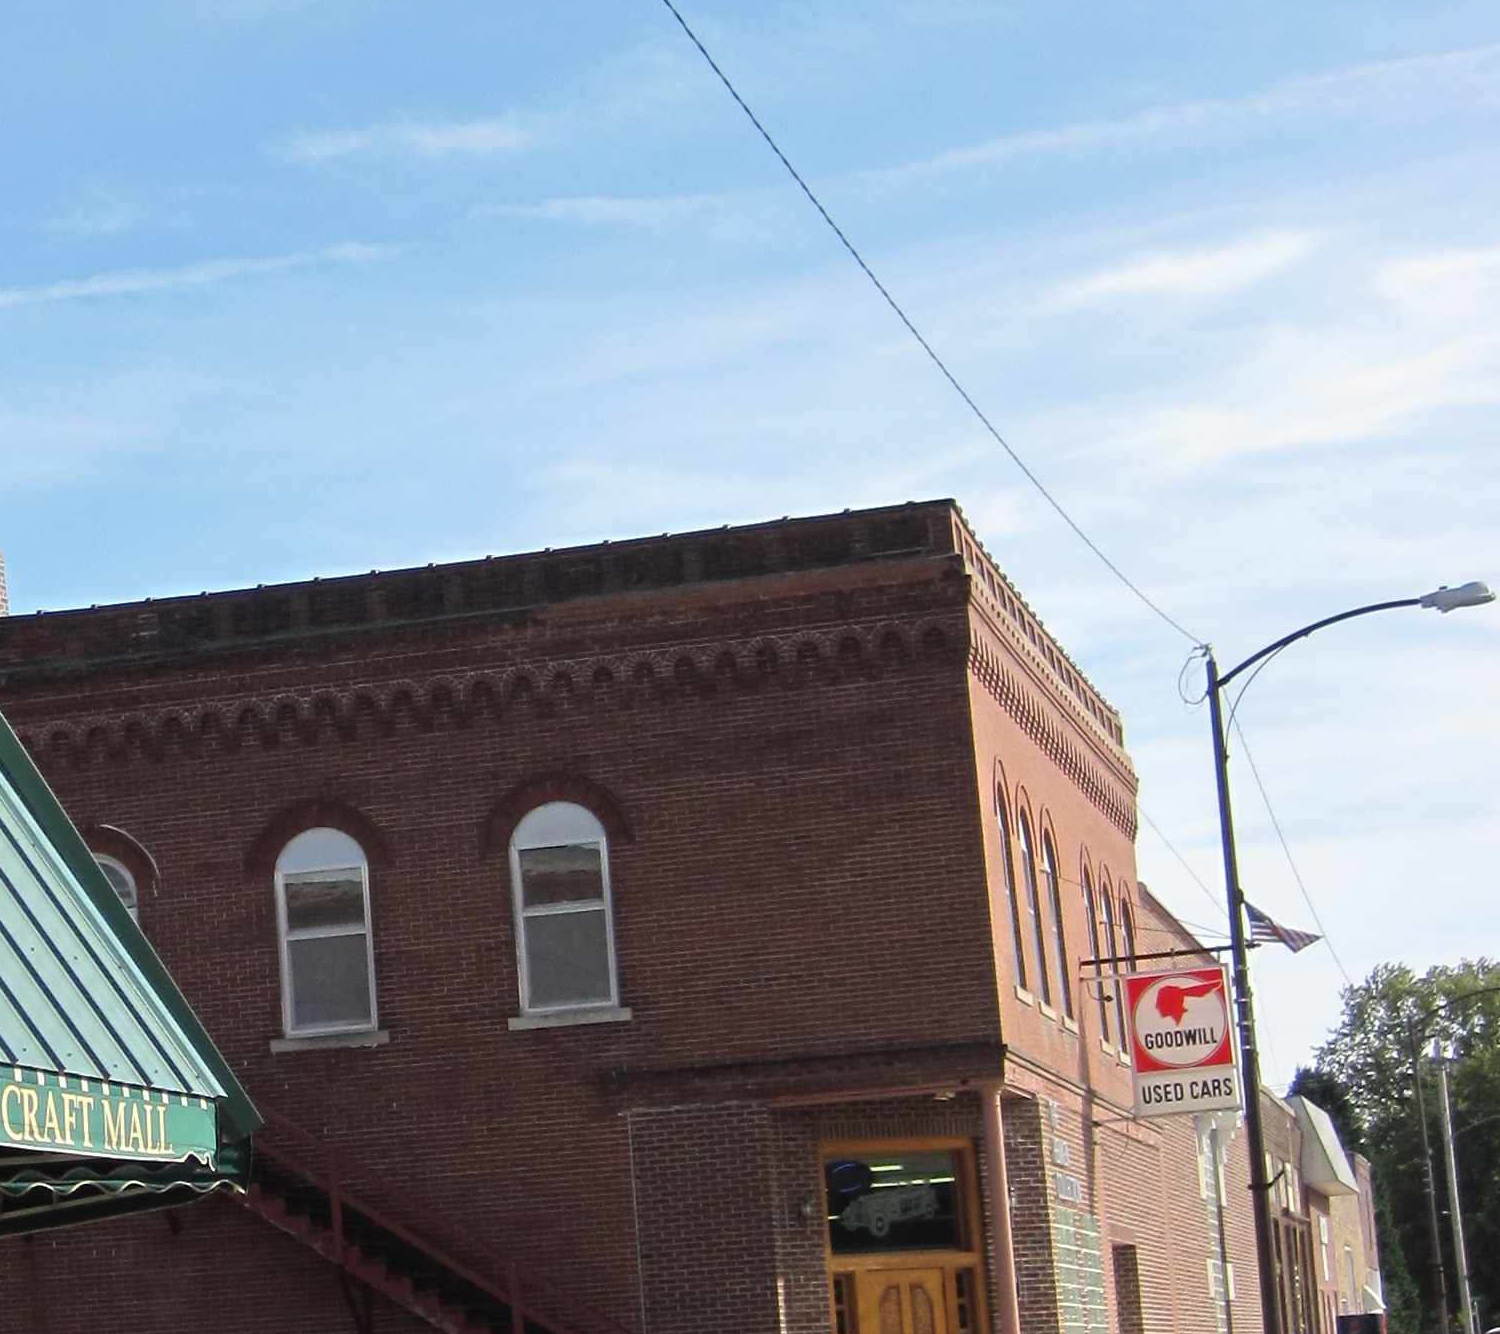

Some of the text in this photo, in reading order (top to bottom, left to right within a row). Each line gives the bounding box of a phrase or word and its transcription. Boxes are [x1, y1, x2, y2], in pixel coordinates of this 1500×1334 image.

[1144, 1027, 1218, 1050] GOODWILL
[1142, 1077, 1233, 1105] USED CARS
[1, 1084, 95, 1148] CRAFT
[102, 1098, 175, 1155] MALL
